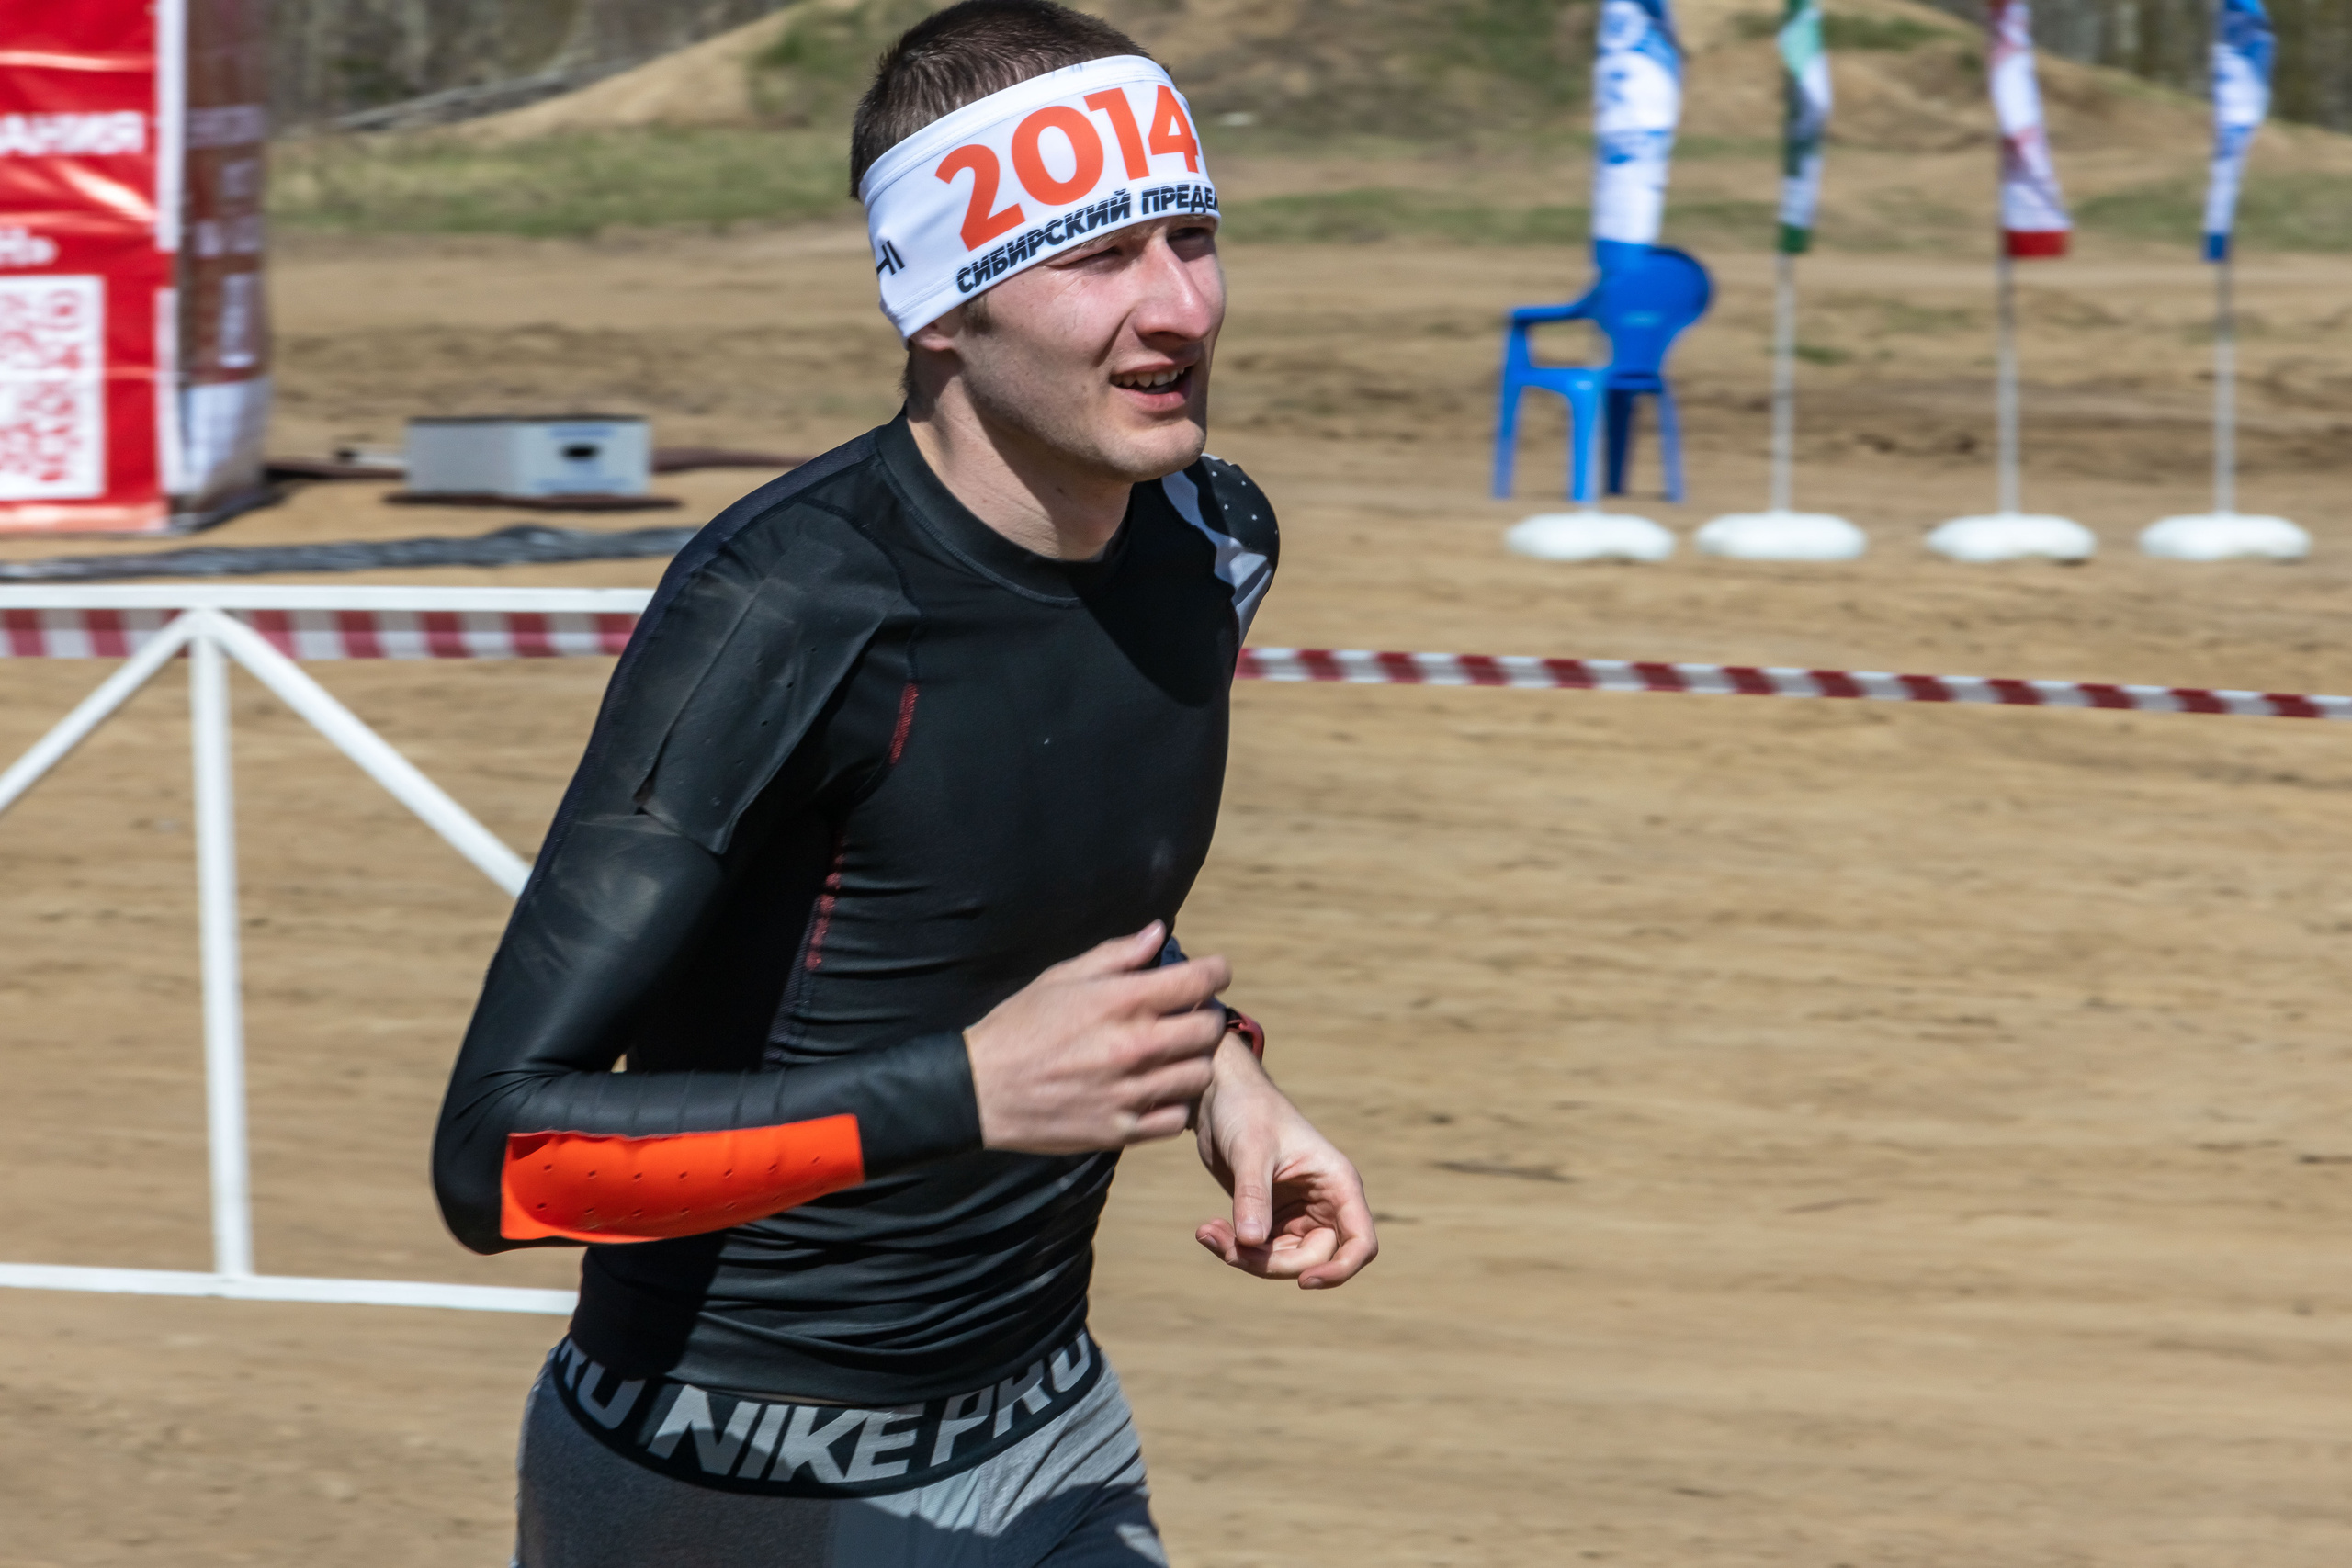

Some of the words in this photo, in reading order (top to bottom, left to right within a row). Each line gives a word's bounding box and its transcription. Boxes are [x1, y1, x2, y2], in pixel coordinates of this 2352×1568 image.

[935, 85, 1199, 252] 2014
[956, 189, 1132, 294] СИБИРСКИЙ
[646, 1384, 924, 1483] NIKE
[930, 1329, 1091, 1467] PRO
